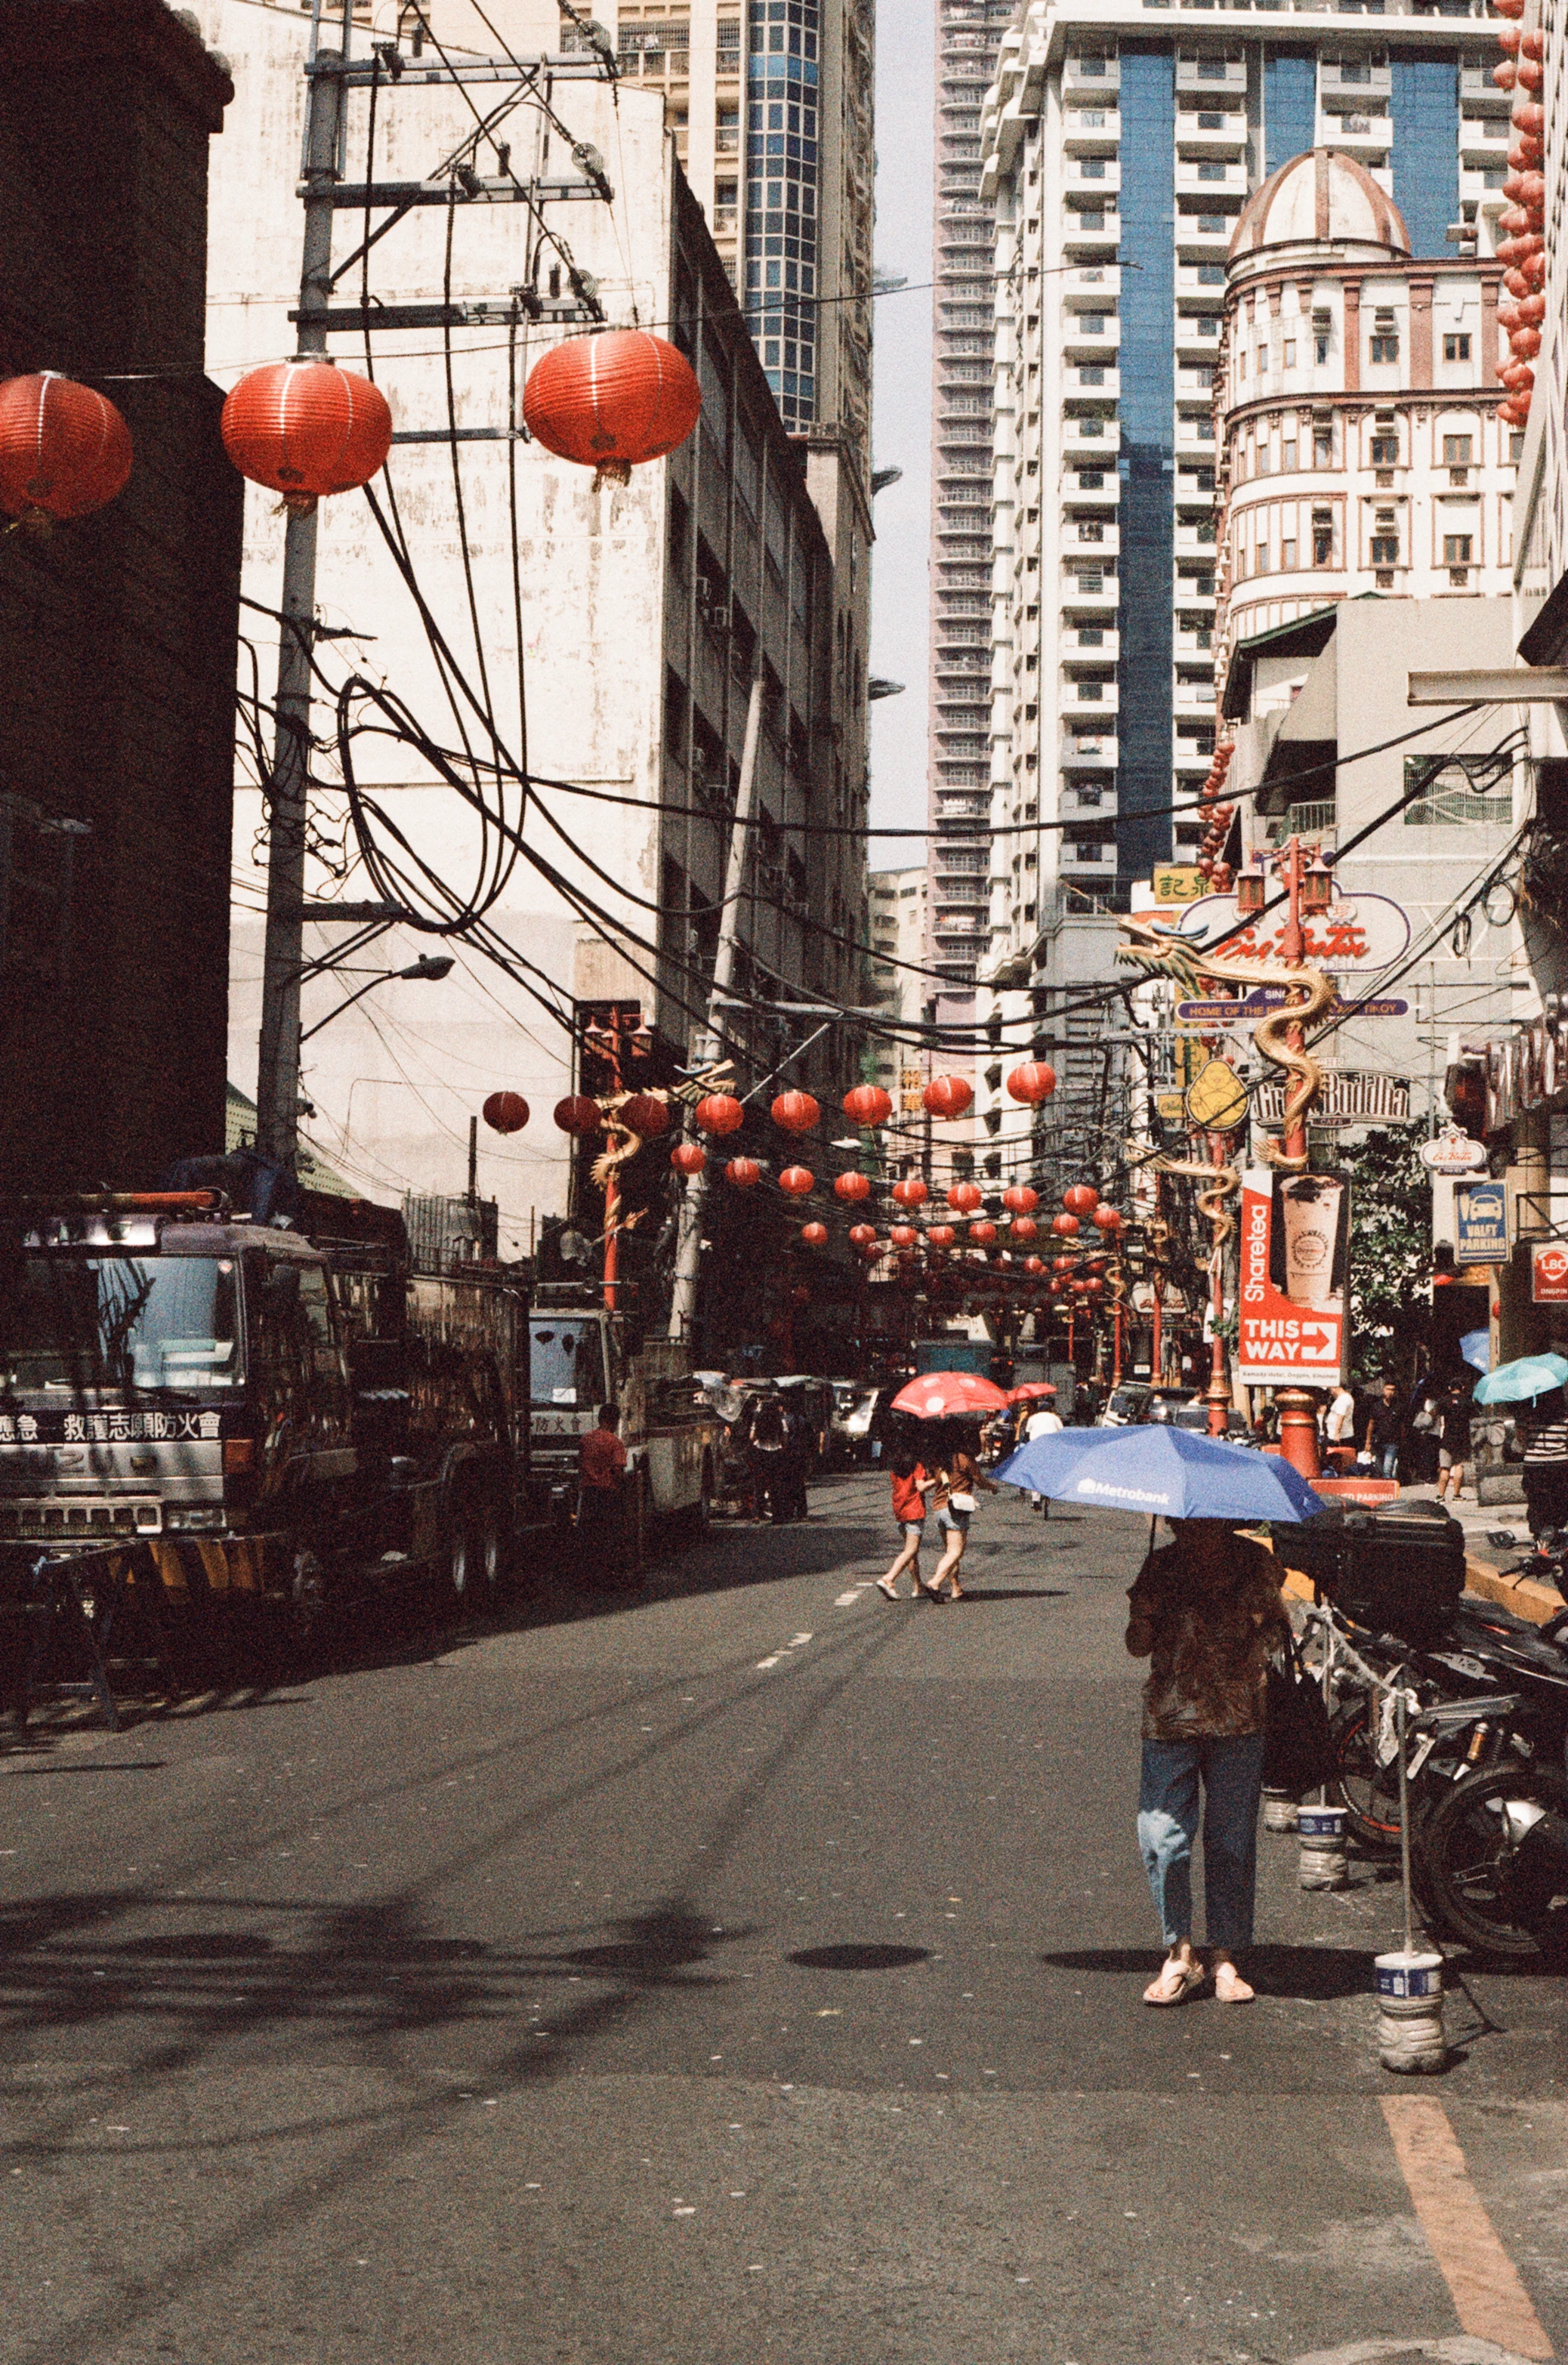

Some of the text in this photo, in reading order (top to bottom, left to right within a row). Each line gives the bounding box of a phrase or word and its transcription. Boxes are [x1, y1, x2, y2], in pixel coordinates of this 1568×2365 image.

[1189, 1006, 1222, 1016] HOME
[1224, 1006, 1239, 1016] OF
[1243, 1005, 1264, 1016] THE
[1323, 1073, 1409, 1117] Buddha
[1466, 1224, 1497, 1237] VALET
[1459, 1237, 1505, 1252] PARKING
[1244, 1205, 1267, 1302] Sharetea
[1541, 1258, 1568, 1270] LBC
[1244, 1319, 1300, 1339] THIS
[1245, 1341, 1301, 1360] WAY
[1095, 1482, 1170, 1505] Metrobank
[1357, 1493, 1394, 1502] PARKING
